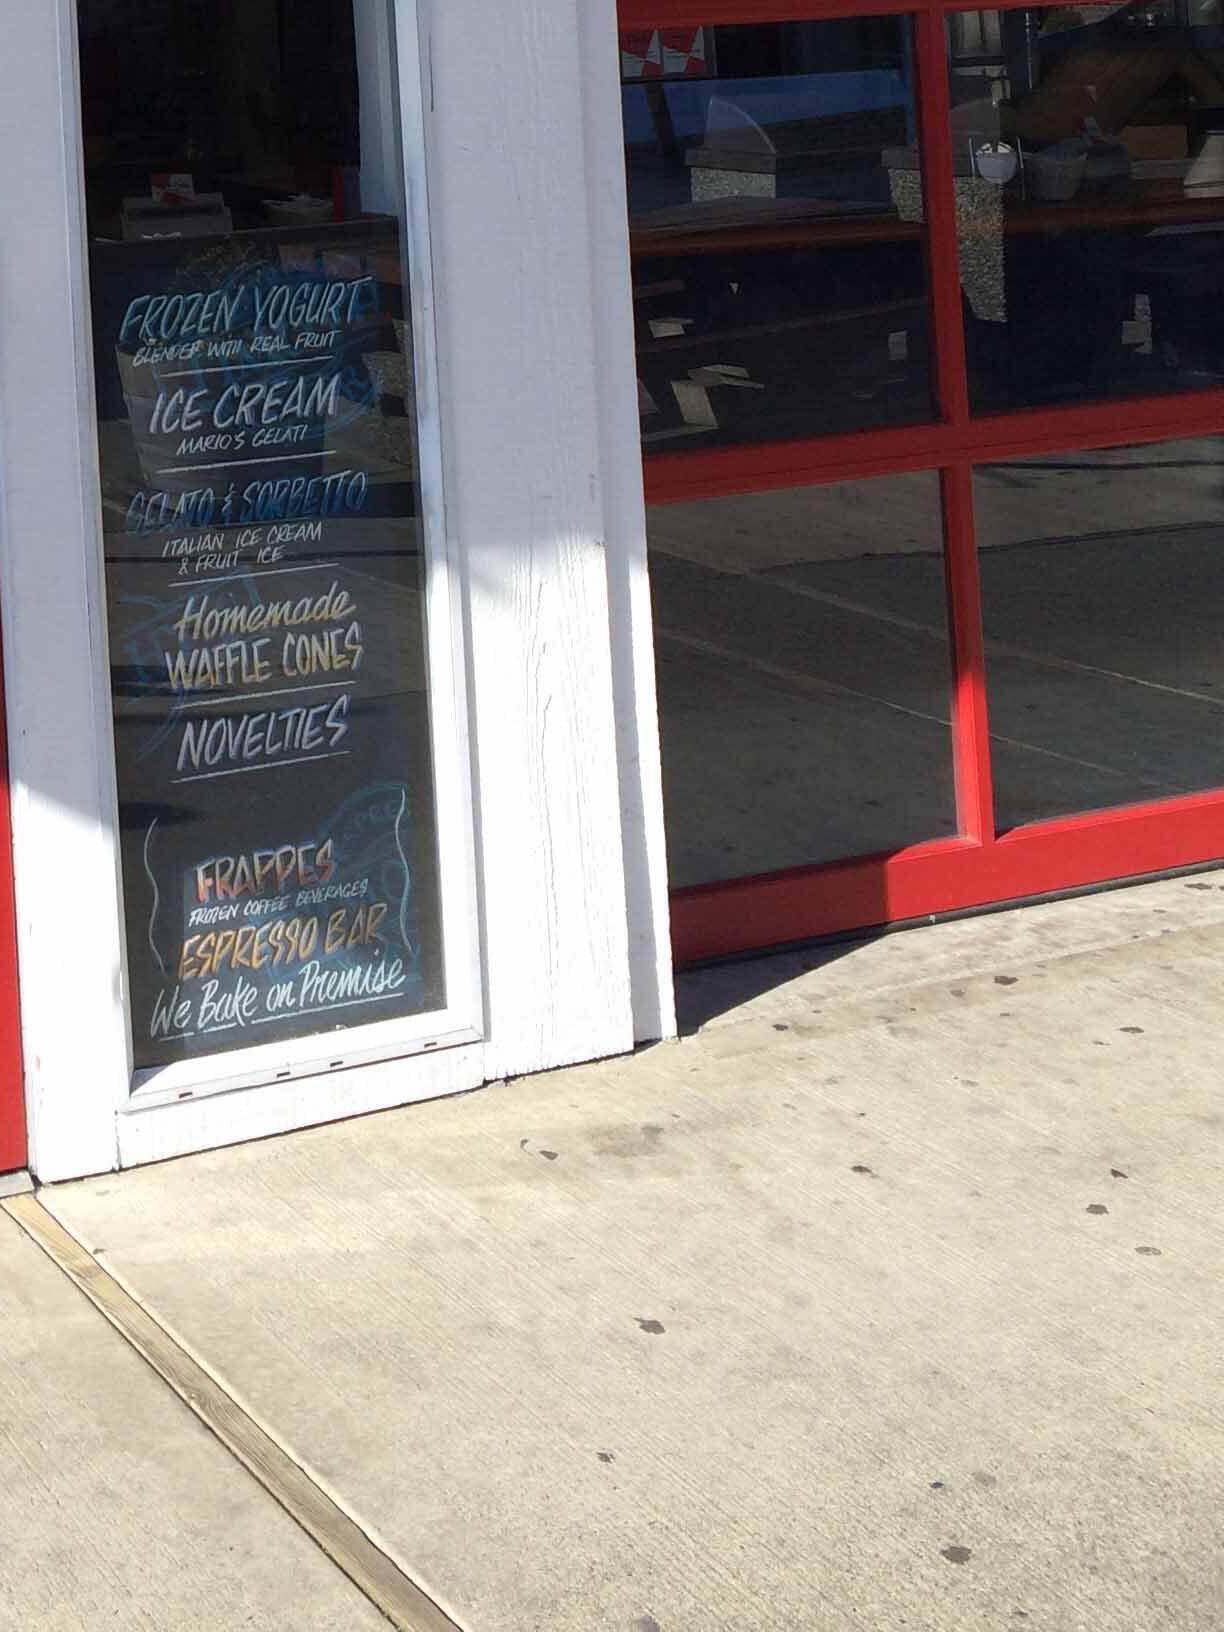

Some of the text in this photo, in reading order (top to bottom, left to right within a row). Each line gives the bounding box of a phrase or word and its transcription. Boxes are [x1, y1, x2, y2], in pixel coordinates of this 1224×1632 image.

[119, 276, 373, 342] FROZEN YOGURT
[207, 338, 243, 358] WITH
[250, 334, 289, 353] REAL
[294, 329, 342, 350] FRUIT
[149, 374, 341, 434] ICE CREAM
[176, 423, 309, 457] MARIO'S GELATI
[239, 469, 368, 524] SORBETTO
[162, 521, 323, 558] ITALIAN ICE CREAM
[195, 549, 243, 573] FRUIT
[256, 544, 286, 564] ICE
[173, 580, 357, 641] Homemade
[165, 620, 364, 690] WAFFLE CONES
[176, 694, 351, 772] NOVELTIES
[194, 839, 335, 903] FRAPPES
[188, 877, 369, 928] FROZEN COFFEE BEVERAGES
[179, 903, 389, 981] ESPRESSO BAR
[149, 951, 408, 1038] We Bake on Premise
